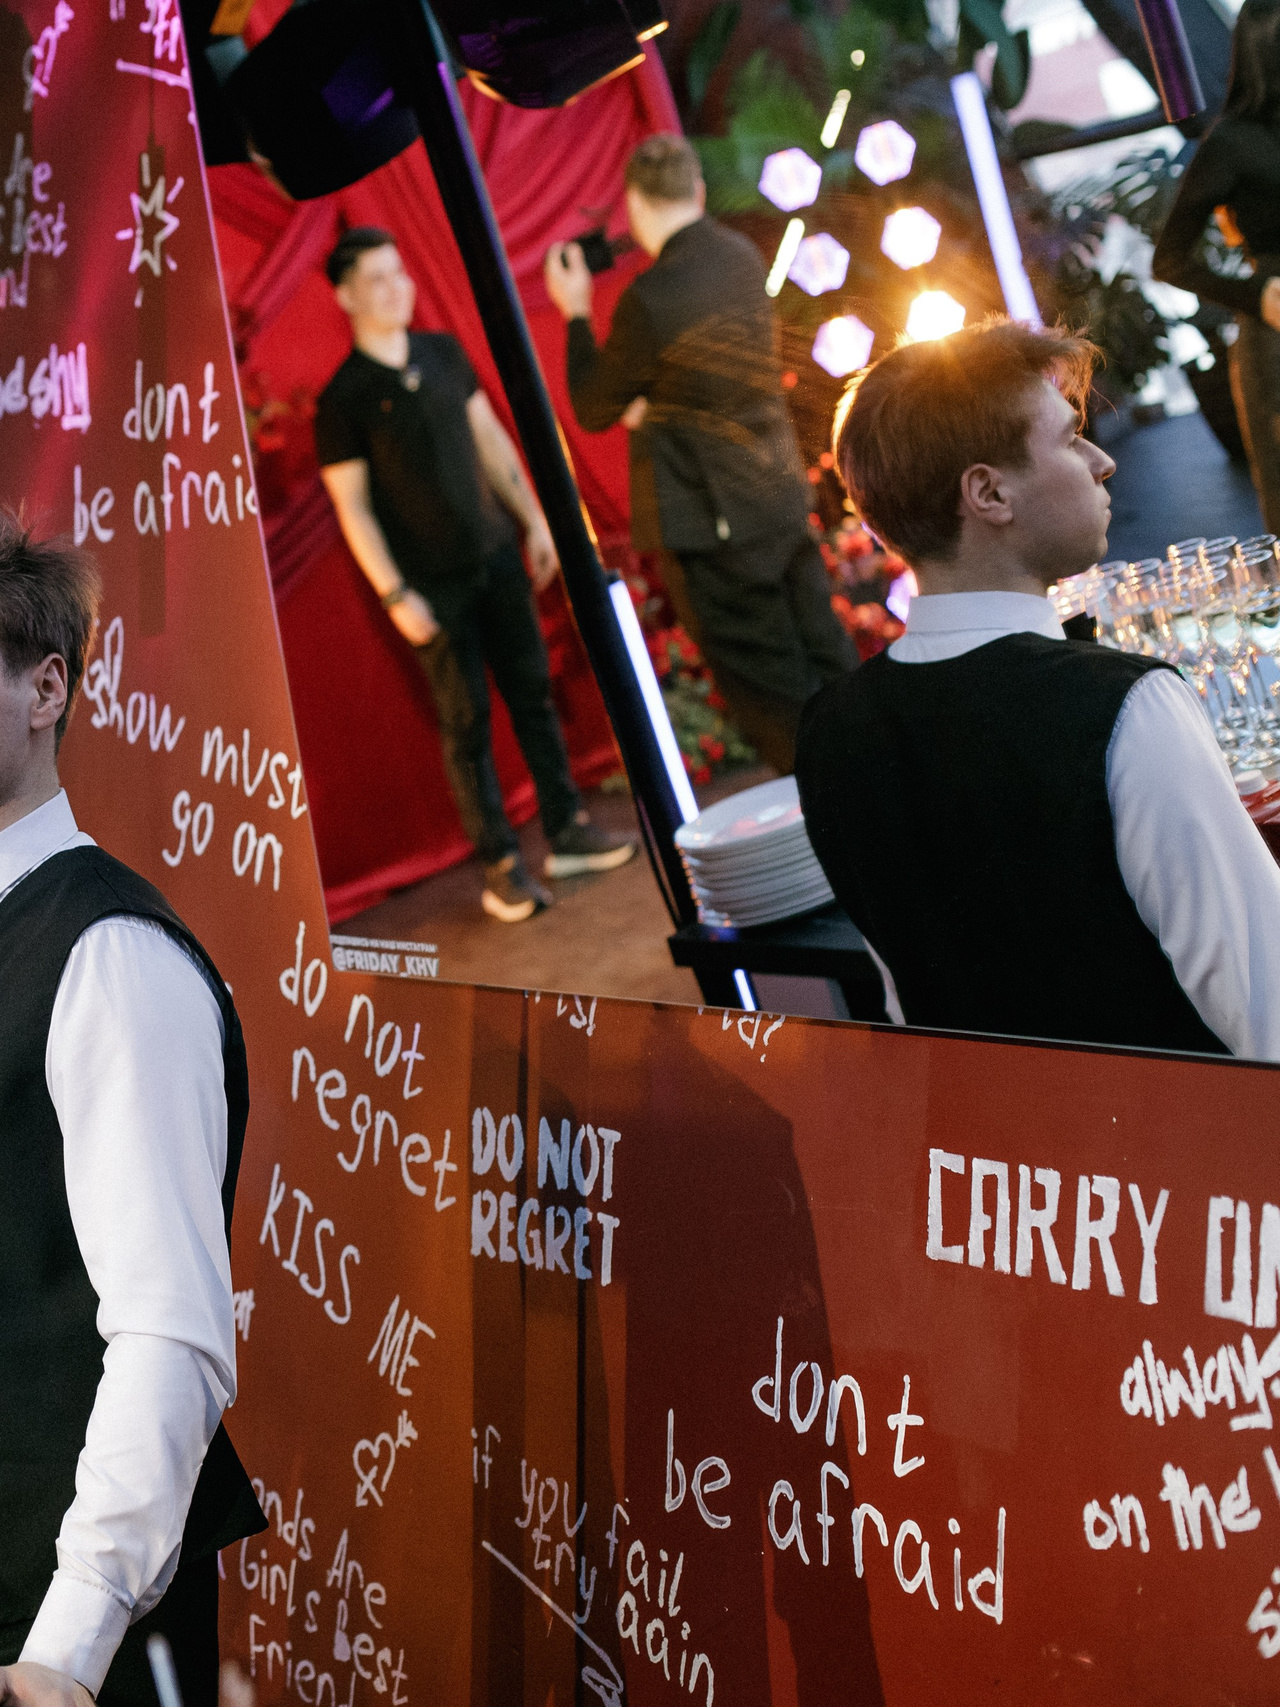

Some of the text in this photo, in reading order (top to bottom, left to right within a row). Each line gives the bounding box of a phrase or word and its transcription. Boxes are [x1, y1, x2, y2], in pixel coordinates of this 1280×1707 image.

[73, 464, 116, 547] be
[162, 790, 283, 891] go on
[278, 921, 328, 1017] do
[344, 993, 425, 1099] not
[332, 946, 440, 978] @FRIDAY_KHV
[291, 1046, 458, 1212] regret
[471, 1106, 622, 1202] DO NOT
[259, 1162, 361, 1325] KISS
[470, 1189, 620, 1287] REGRET
[926, 1148, 1170, 1305] CARRY
[367, 1294, 436, 1396] ME
[471, 1424, 502, 1490] if
[665, 1408, 1007, 1626] be afraid
[1083, 1494, 1150, 1554] on
[1159, 1462, 1262, 1552] the
[326, 1528, 387, 1630] Are
